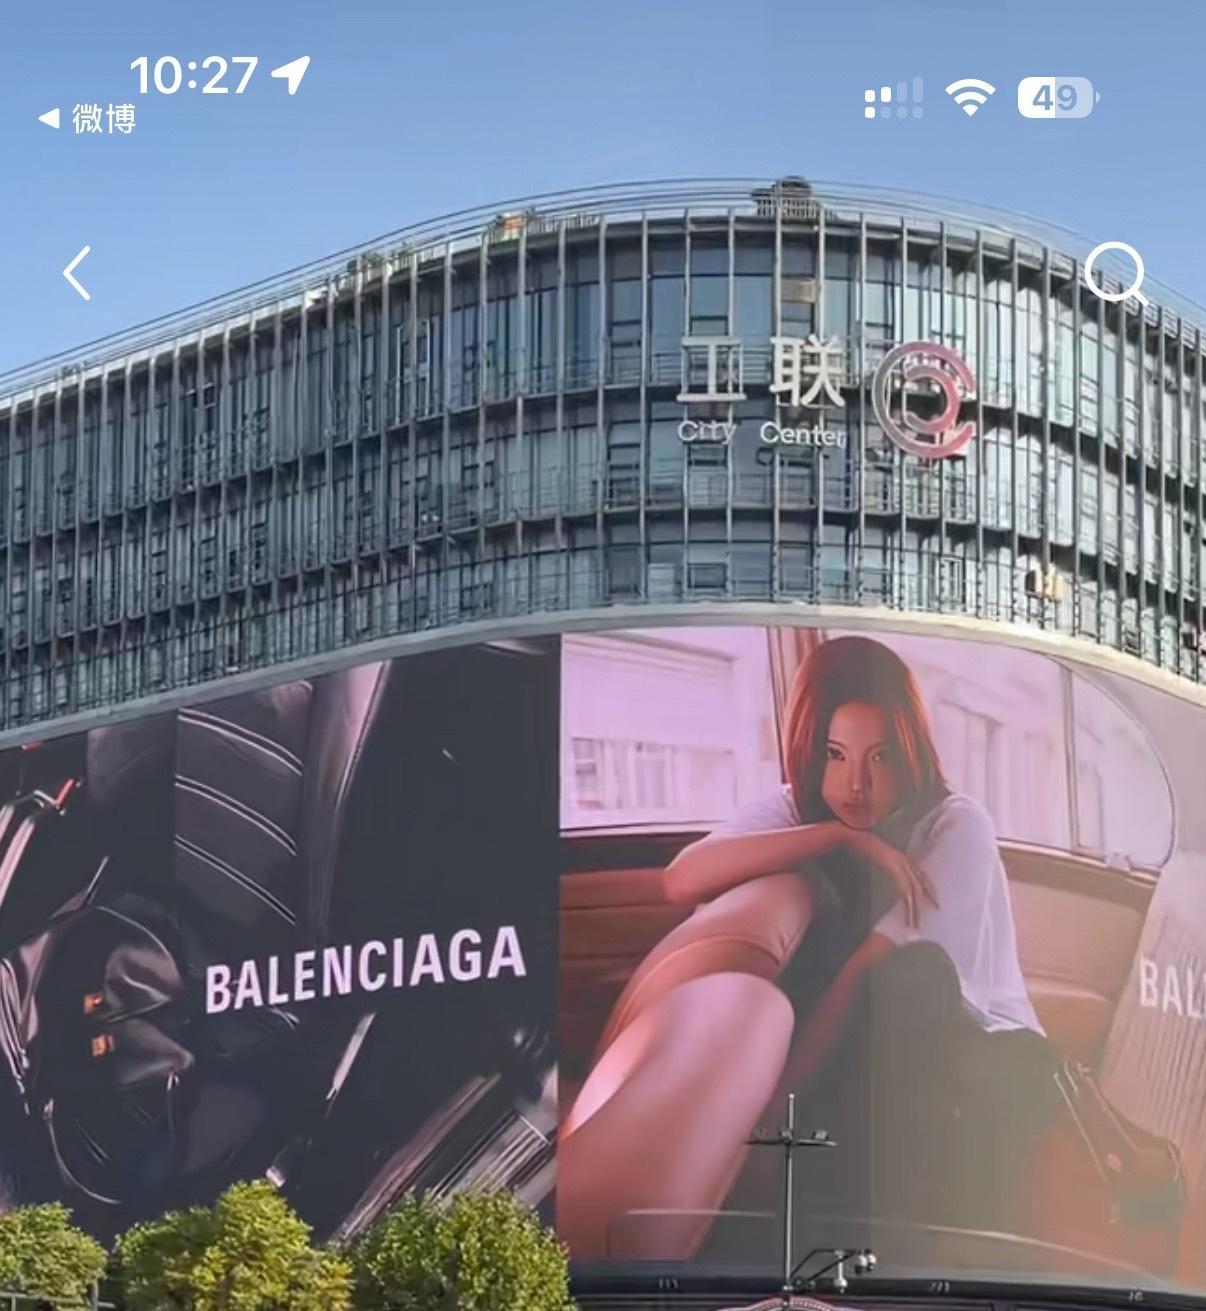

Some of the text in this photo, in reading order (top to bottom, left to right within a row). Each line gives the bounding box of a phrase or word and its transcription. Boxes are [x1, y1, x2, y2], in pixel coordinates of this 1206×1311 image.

[677, 420, 847, 448] City Center
[205, 925, 527, 1015] BALENCIAGA
[1139, 951, 1206, 1021] BAL
